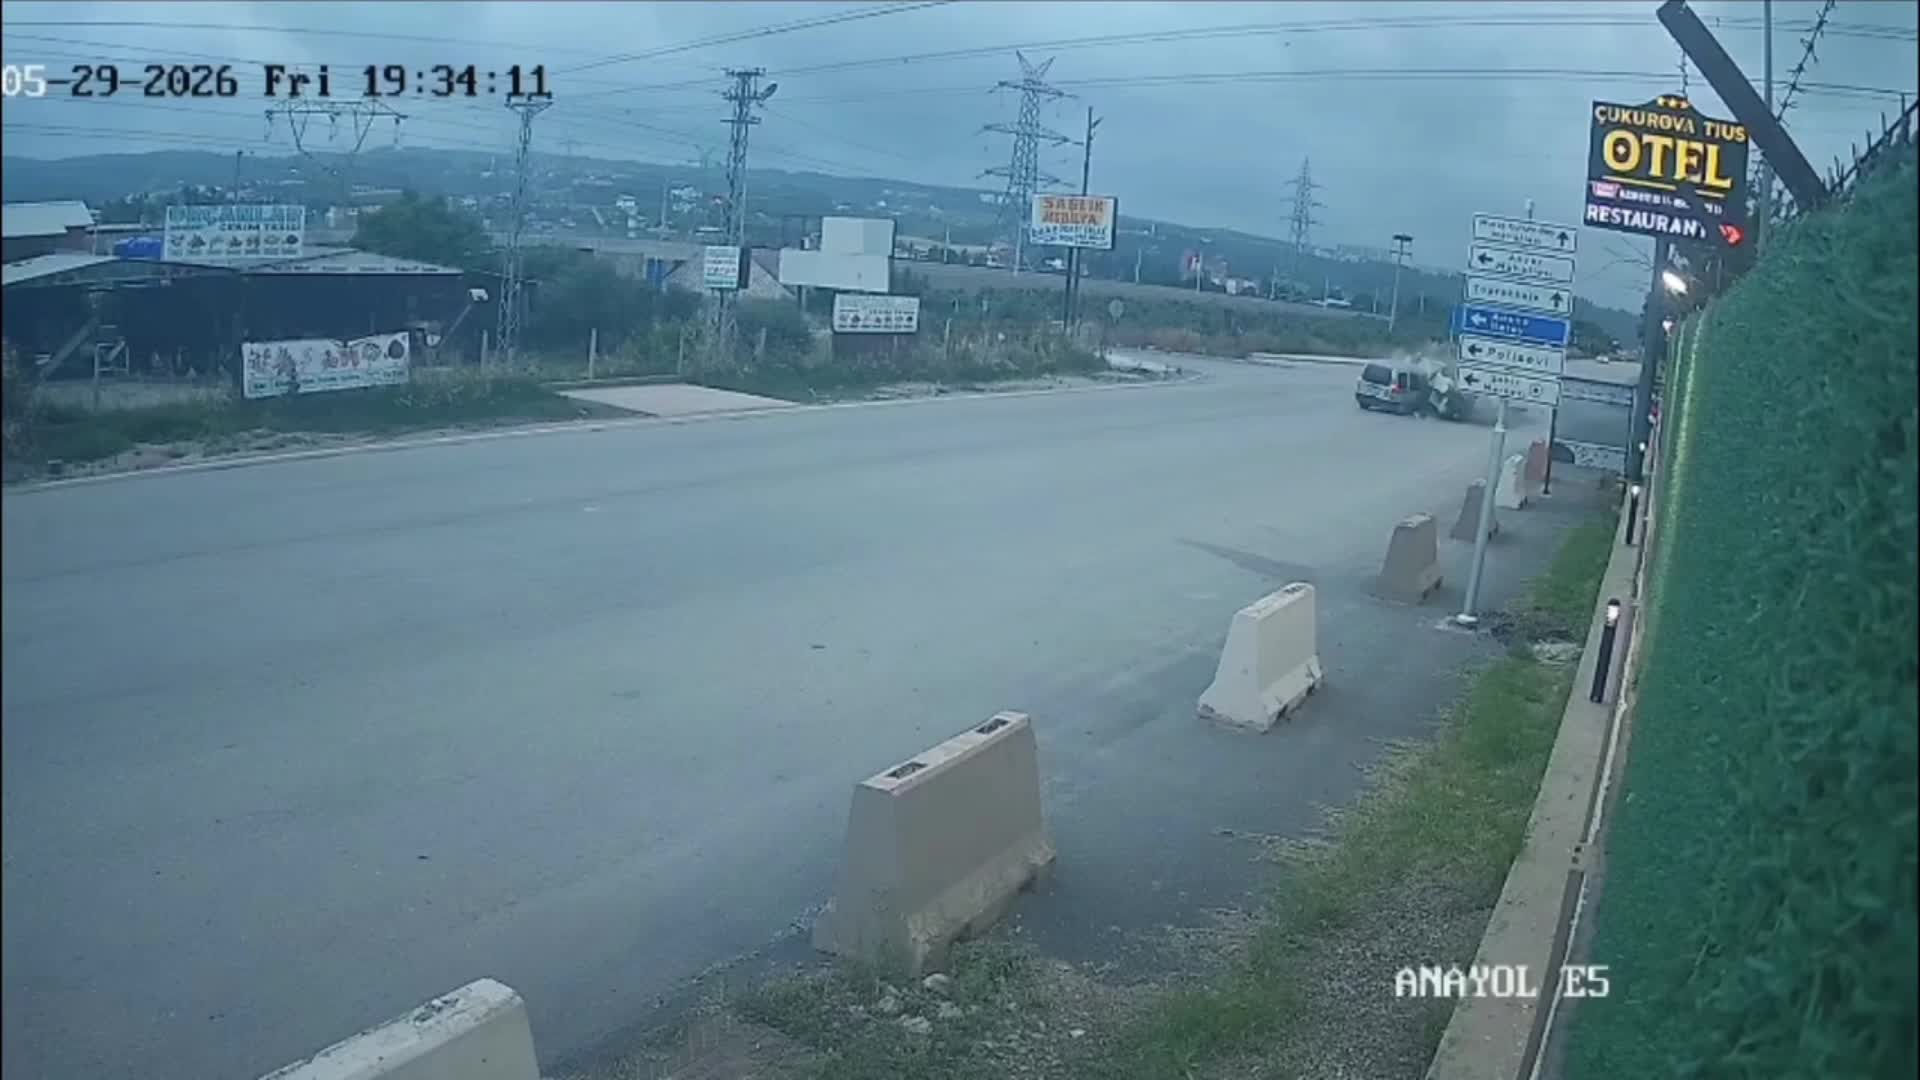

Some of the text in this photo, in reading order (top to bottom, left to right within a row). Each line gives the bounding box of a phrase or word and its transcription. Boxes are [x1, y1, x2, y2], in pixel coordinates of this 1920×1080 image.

[1594, 105, 1696, 133] ÇUKUROVA
[1602, 128, 1733, 188] OTEL
[1487, 346, 1549, 368] Polisevi
